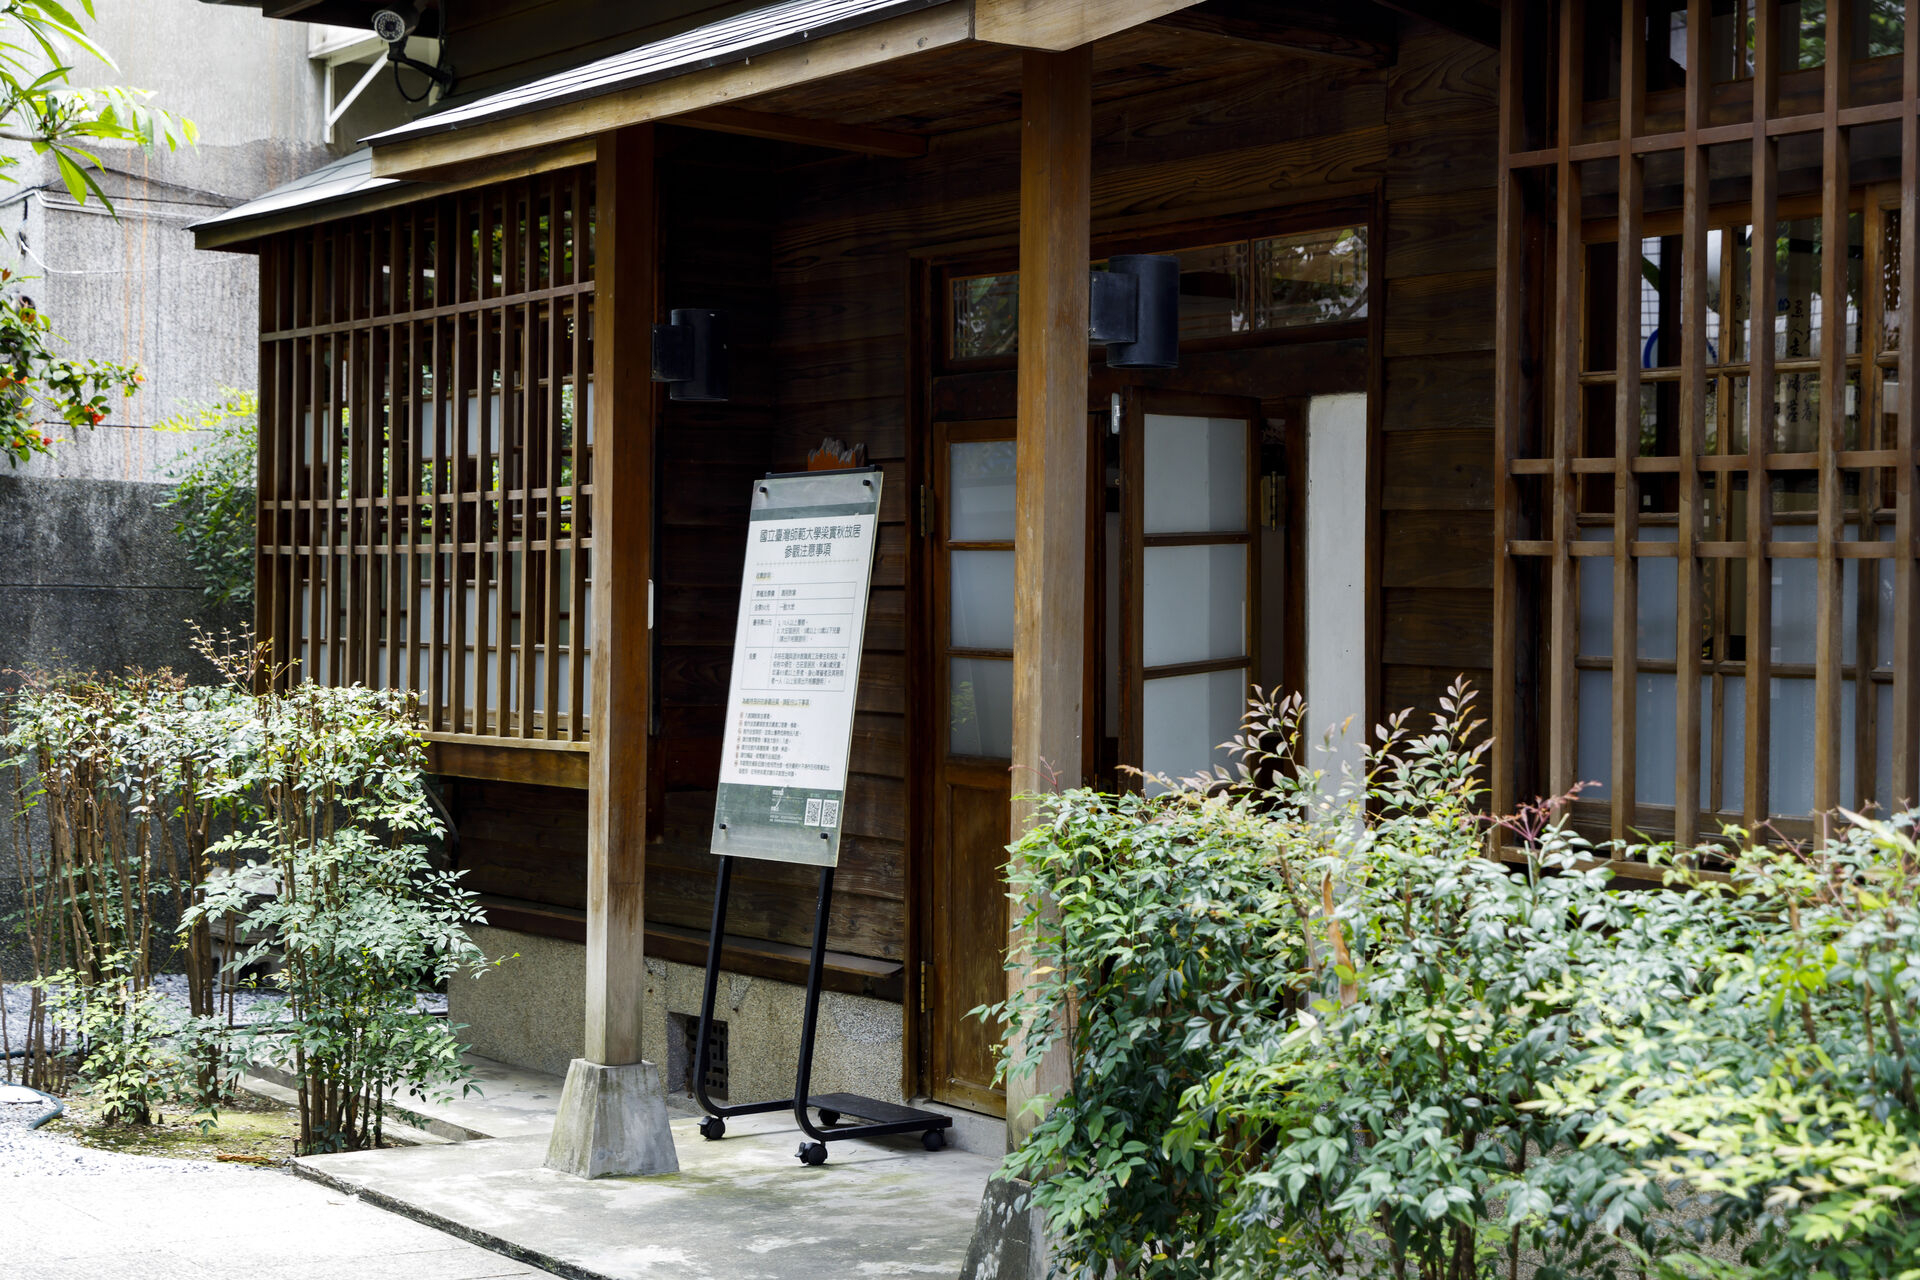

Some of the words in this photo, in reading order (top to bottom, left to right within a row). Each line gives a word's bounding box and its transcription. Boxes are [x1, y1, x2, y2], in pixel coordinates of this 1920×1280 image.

[760, 524, 861, 543] 國立臺灣師範大學梁實秋故居
[785, 543, 831, 558] 參觀注意事項
